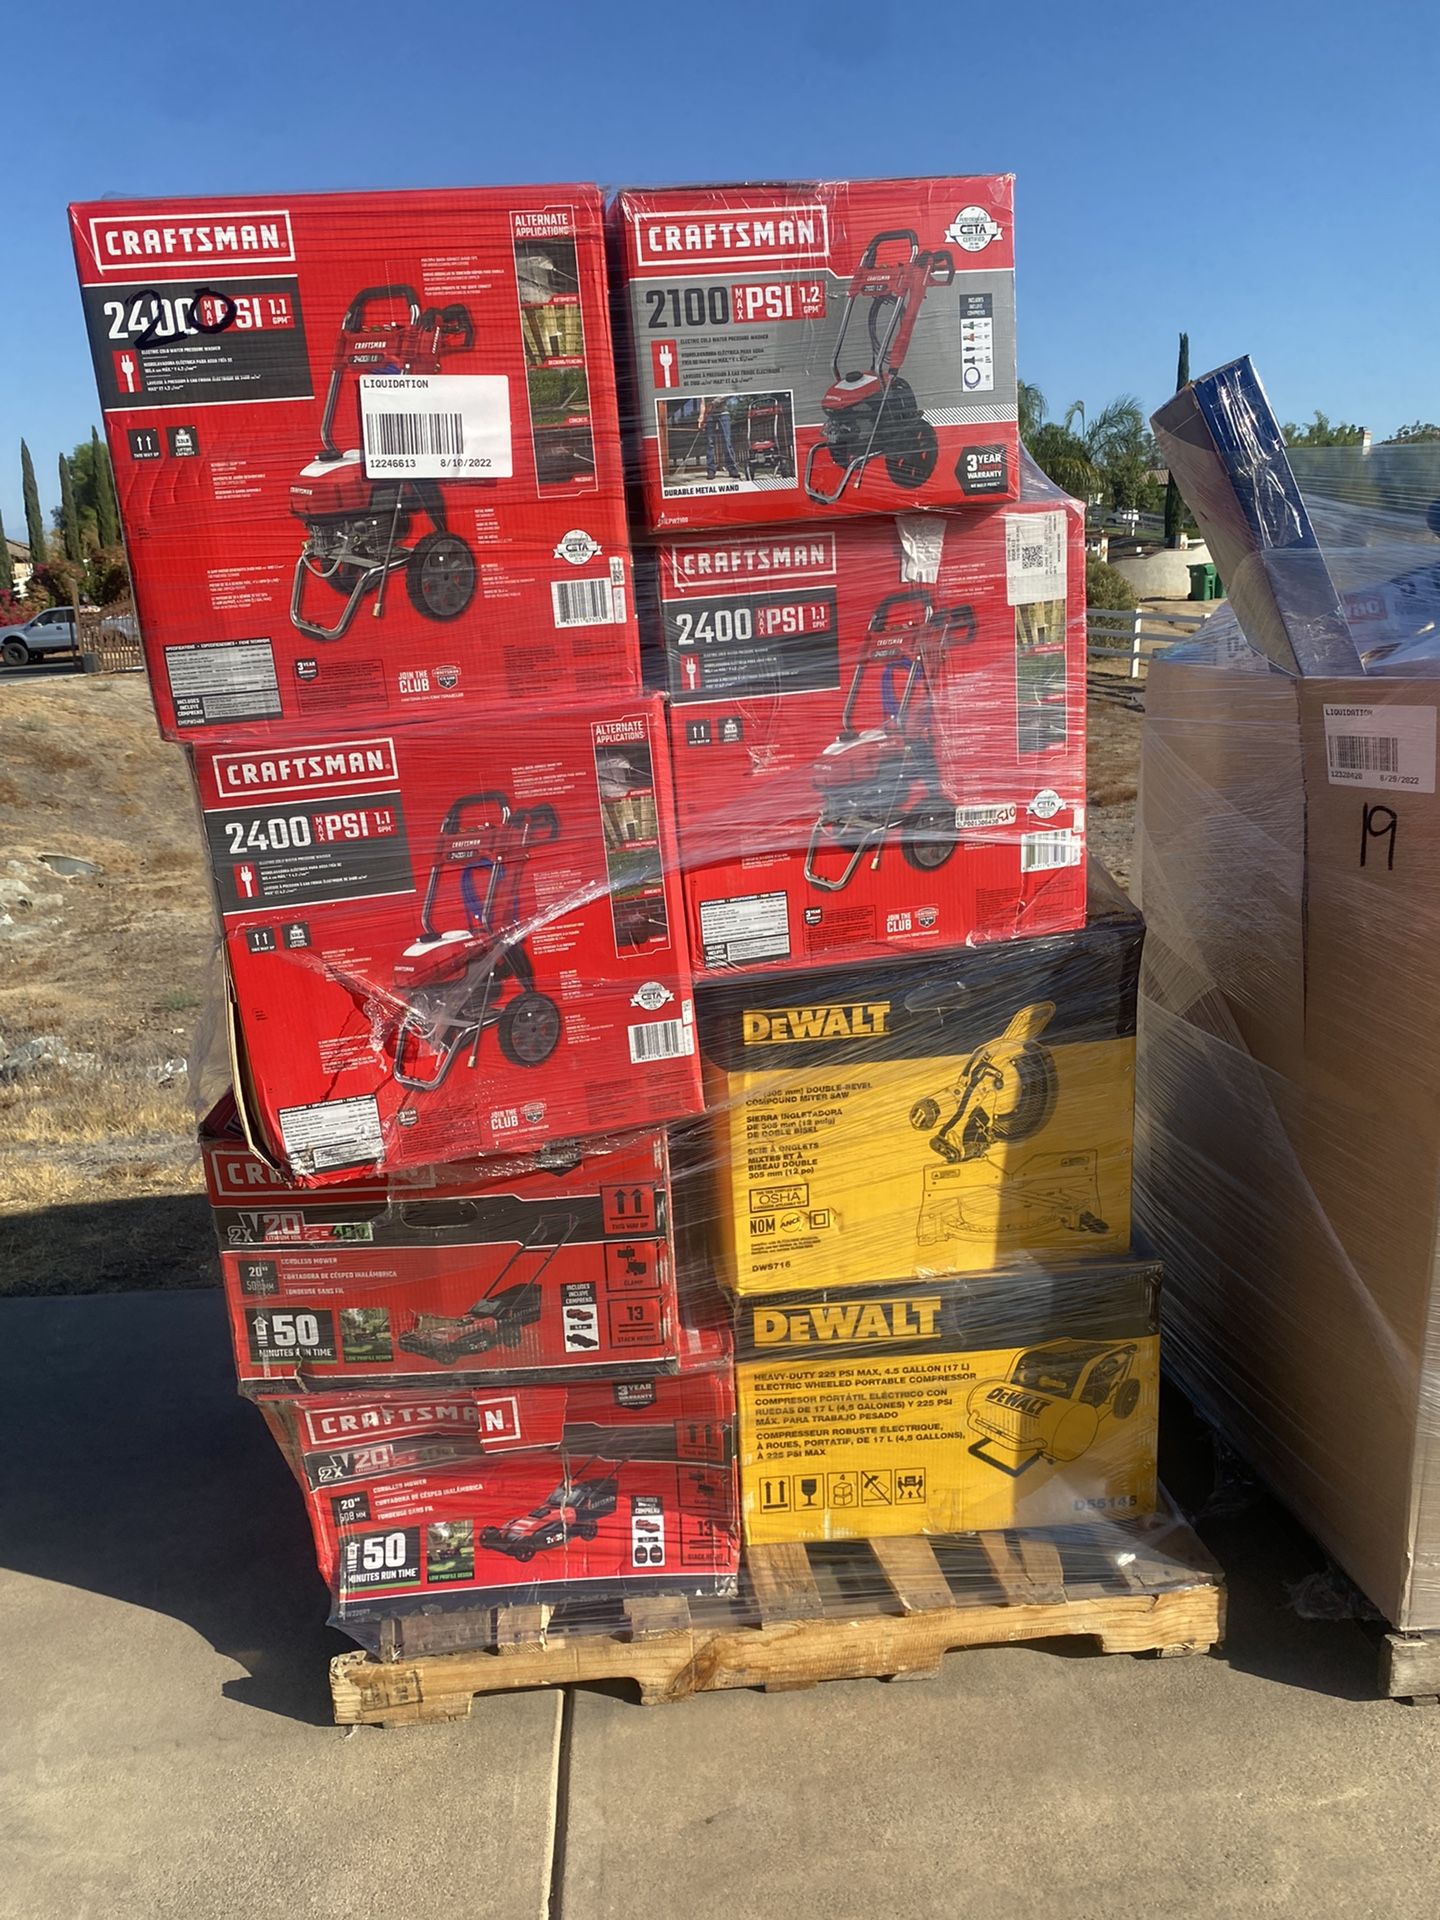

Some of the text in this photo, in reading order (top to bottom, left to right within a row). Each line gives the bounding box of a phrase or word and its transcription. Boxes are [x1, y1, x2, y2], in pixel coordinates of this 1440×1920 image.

[515, 213, 568, 226] ALTERNATE
[516, 226, 569, 237] APPLICATIONS
[648, 219, 815, 252] CRAFTSMAN
[961, 224, 987, 234] CETA
[105, 224, 279, 256] CRAFTSMAN
[269, 299, 287, 315] 1.1
[646, 285, 820, 328] 2100 MAX PSI 1.2
[364, 380, 428, 388] LIQUIDATION
[370, 459, 492, 469] 12246613 8/10/2022
[967, 454, 1002, 471] 3 YEAR
[967, 470, 1002, 479] WARRANTY
[664, 484, 739, 497] DURABLE METAL WAND
[566, 544, 589, 552] CETA
[684, 544, 825, 574] CRAFTSMAN
[676, 609, 752, 645] 2400
[767, 607, 805, 634] PSI
[811, 606, 825, 620] 1.1
[398, 672, 414, 680] JOIN
[415, 670, 428, 679] THE
[400, 679, 429, 693] CLUB
[596, 721, 643, 736] ALTERNATE
[596, 731, 645, 744] APPLICATIONS
[227, 750, 383, 785] CRAFTSMAN
[225, 812, 391, 854] 2400 MAX PSI 1.1
[452, 840, 480, 848] CRAFTSMAN
[887, 920, 912, 932] CLUB
[641, 992, 662, 1000] CETA
[807, 1083, 872, 1093] DOUBLE-BEVEL
[746, 1096, 797, 1106] COMPOUND
[491, 1116, 518, 1130] CLUB
[747, 1109, 842, 1123] SIERRA INGLETADORA
[779, 1143, 819, 1151] ONGLETS
[748, 1155, 780, 1164] MIXTES
[783, 1159, 817, 1167] DOUBLE
[785, 1169, 798, 1177] (12
[801, 1167, 814, 1175] po)
[760, 1192, 800, 1205] OSHA
[750, 1218, 775, 1234] NOM
[627, 1306, 643, 1321] 13
[754, 1300, 941, 1342] DEWALT
[272, 1315, 320, 1346] 50
[259, 1349, 293, 1357] MINUTES
[313, 1348, 332, 1356] TIME
[754, 1372, 816, 1381] HEAVY-DUTY
[885, 1367, 899, 1375] 4.5
[902, 1365, 941, 1373] GALLON
[944, 1364, 959, 1373] (17
[962, 1363, 970, 1371] L)
[754, 1373, 976, 1391] ELECTRIC WHEELED PORTABLE COMPRESSOR
[618, 1386, 628, 1395] 3
[755, 1389, 947, 1406] COMPRESOR PORTÁTIL ELÉCTRICO CON
[756, 1407, 795, 1416] RUEDAS
[815, 1405, 826, 1413] 17
[857, 1401, 905, 1411] GALONES)
[322, 1406, 505, 1434] CRAFTSMAN
[756, 1412, 899, 1426] MÁX. PARA TRABAJO PESADO
[756, 1423, 943, 1440] COMPRESSEUR ROBUSTE ÉLECTRIQUE,
[757, 1442, 763, 1450] À
[766, 1441, 802, 1450] ROUES,
[804, 1438, 853, 1447] PORTATIF,
[916, 1432, 966, 1441] GALLONS),
[757, 1452, 764, 1460] À
[805, 1449, 826, 1457] MAX
[323, 1467, 344, 1480] 2X
[404, 1479, 427, 1488] MOWER
[375, 1496, 410, 1507] CORTADORA
[698, 1521, 713, 1536] 13
[363, 1532, 406, 1570] 50
[349, 1568, 417, 1583] MINUTES RUN TIME
